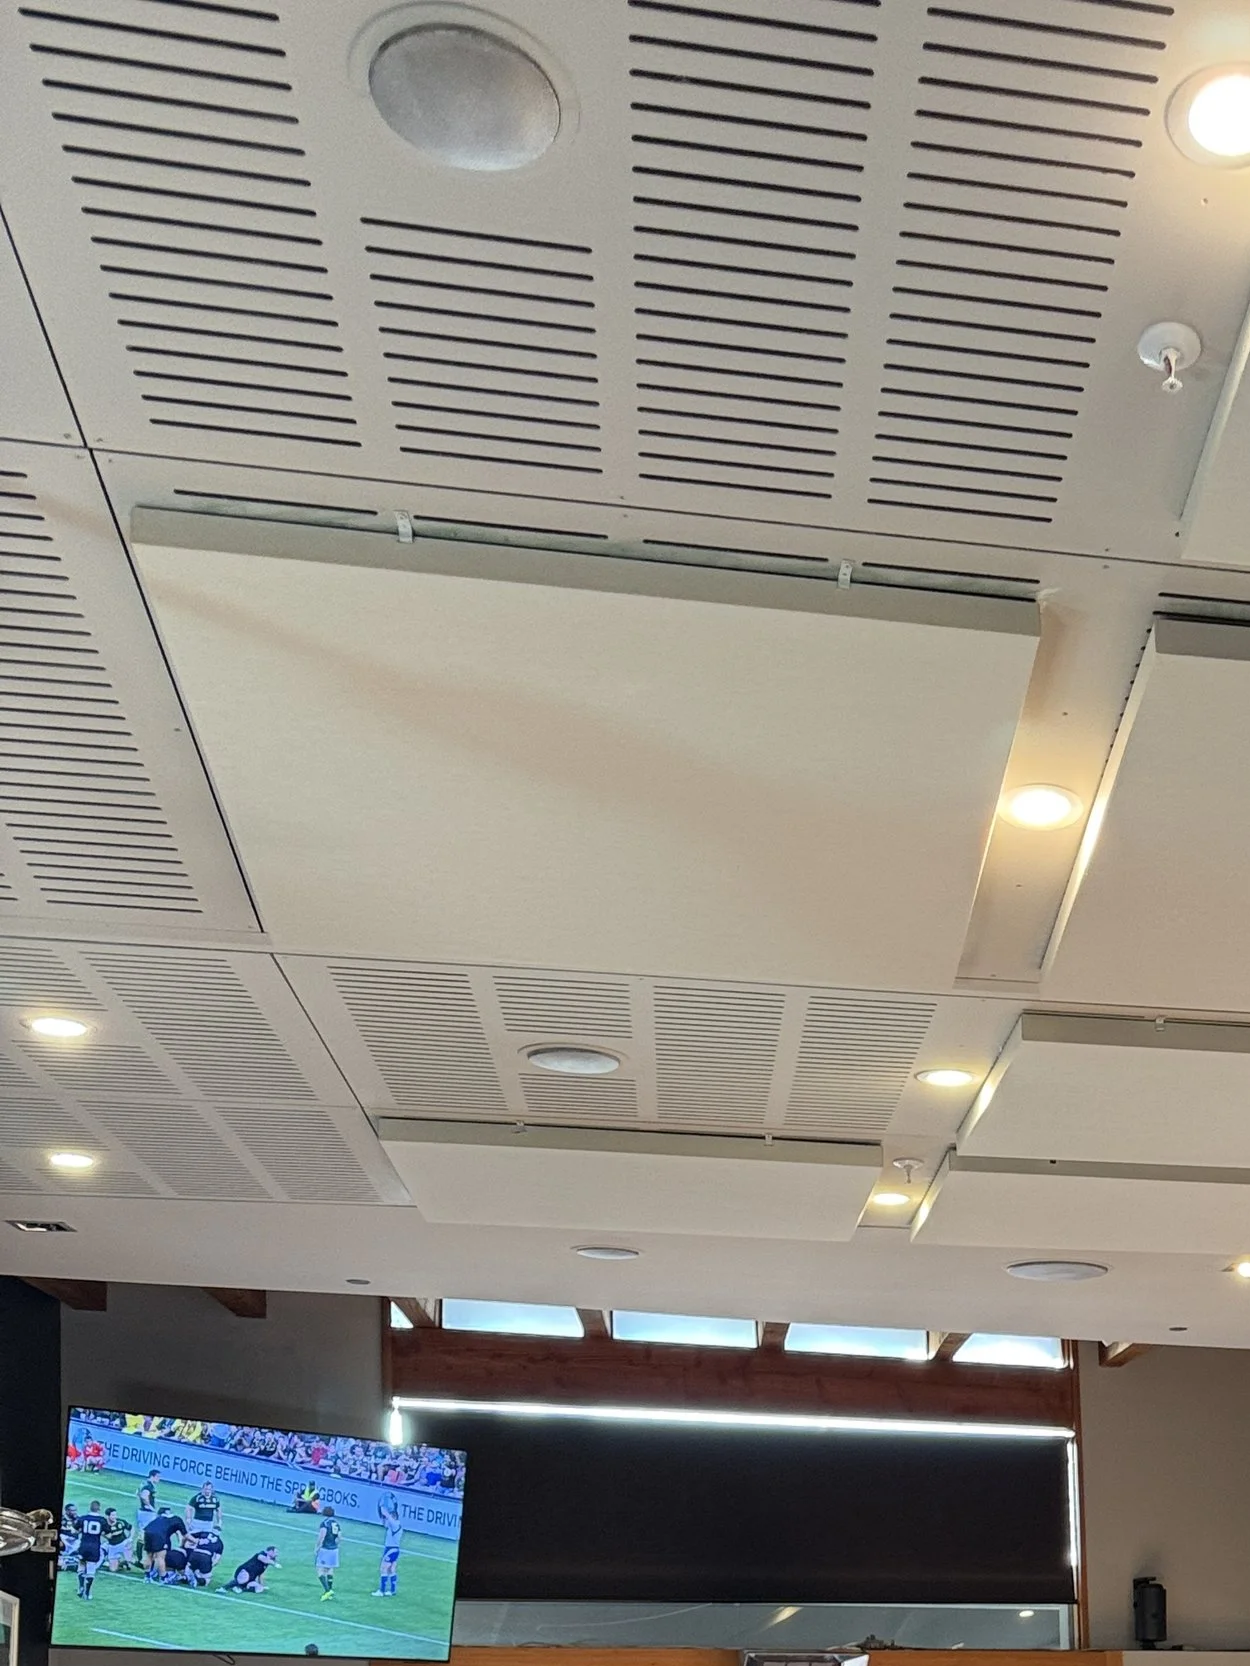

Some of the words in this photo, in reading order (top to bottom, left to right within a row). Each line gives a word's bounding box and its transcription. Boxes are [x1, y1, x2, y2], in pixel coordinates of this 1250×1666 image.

[98, 1440, 119, 1459] THE
[121, 1444, 170, 1469] DRIVING
[172, 1456, 212, 1478] FORCE
[214, 1466, 258, 1487] BEHIND
[260, 1473, 282, 1493] THE
[284, 1479, 360, 1509] SPRGBOKS.
[402, 1503, 425, 1521] THE
[83, 1520, 101, 1535] 10
